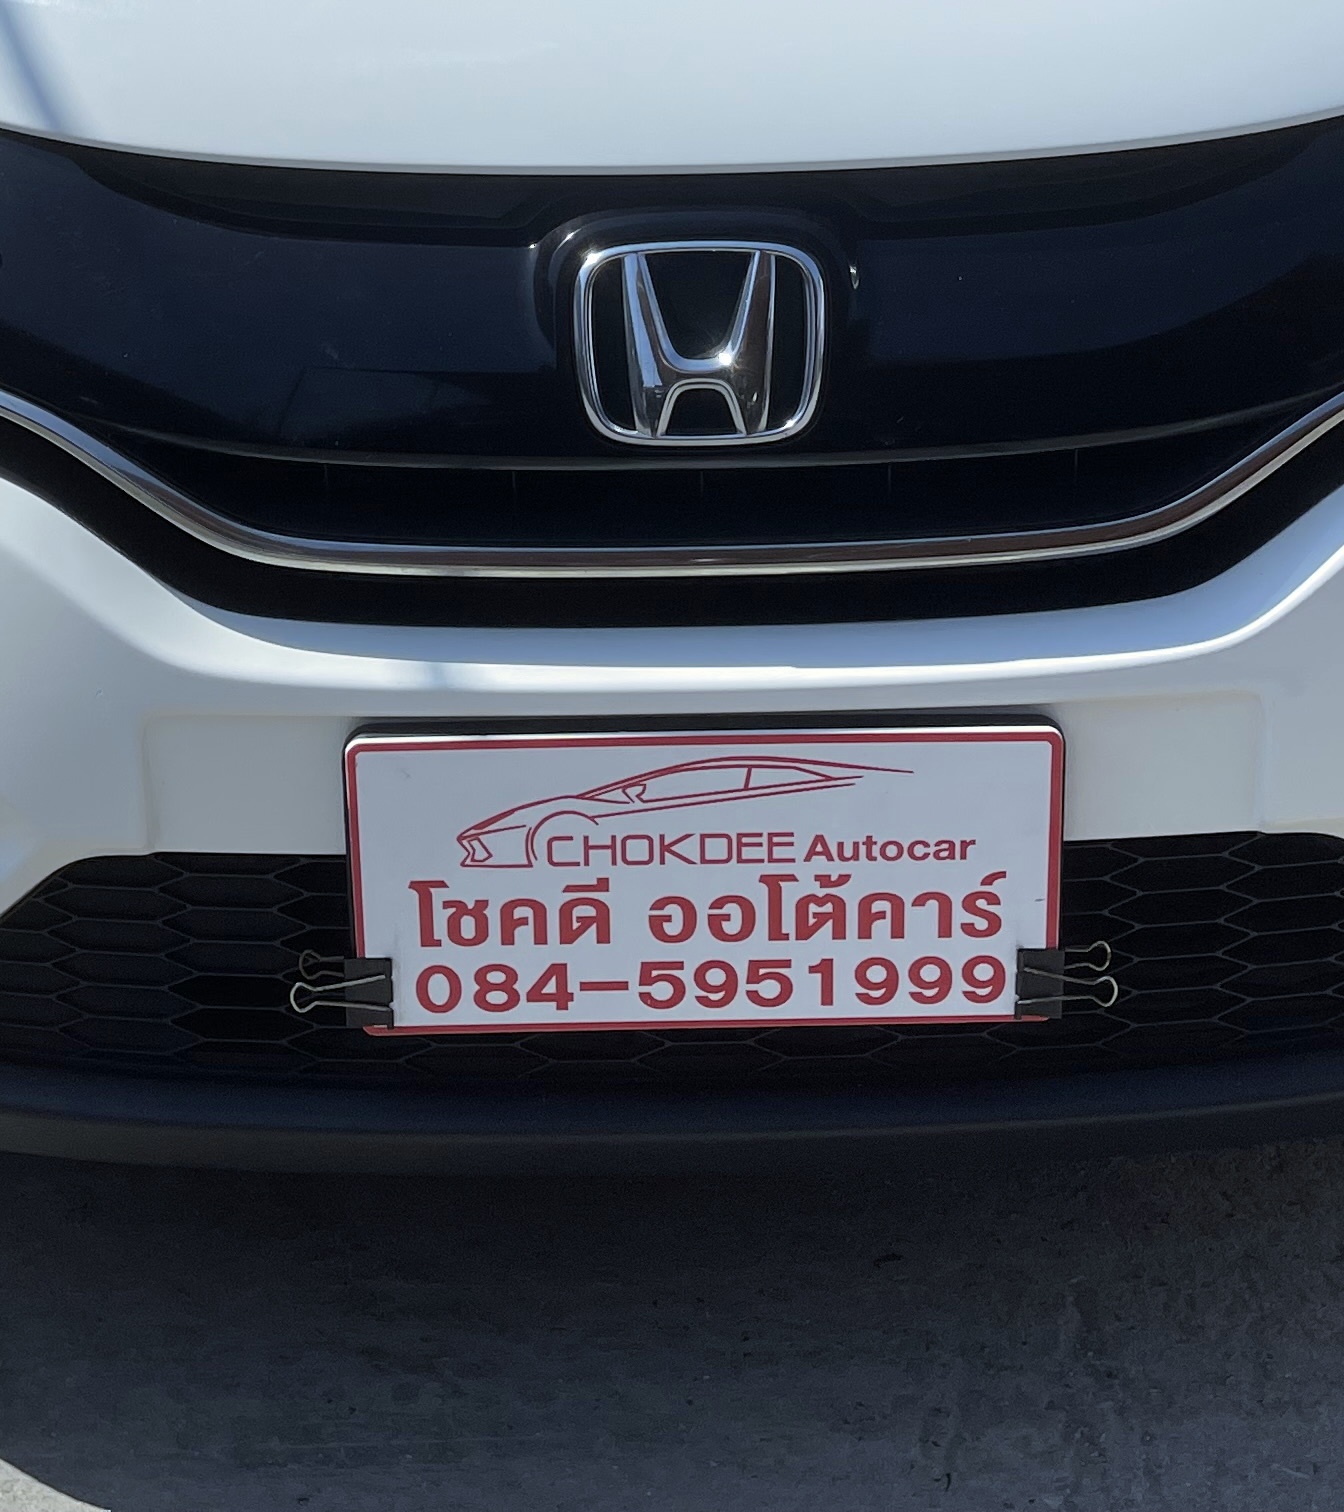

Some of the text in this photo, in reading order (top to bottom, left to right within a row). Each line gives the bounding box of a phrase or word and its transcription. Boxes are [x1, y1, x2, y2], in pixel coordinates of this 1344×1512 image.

[546, 831, 977, 867] CHOKDEE Autocar
[408, 870, 1008, 949] โชคดี ออโต้คาร์
[414, 954, 1008, 1014] 084-5951999
